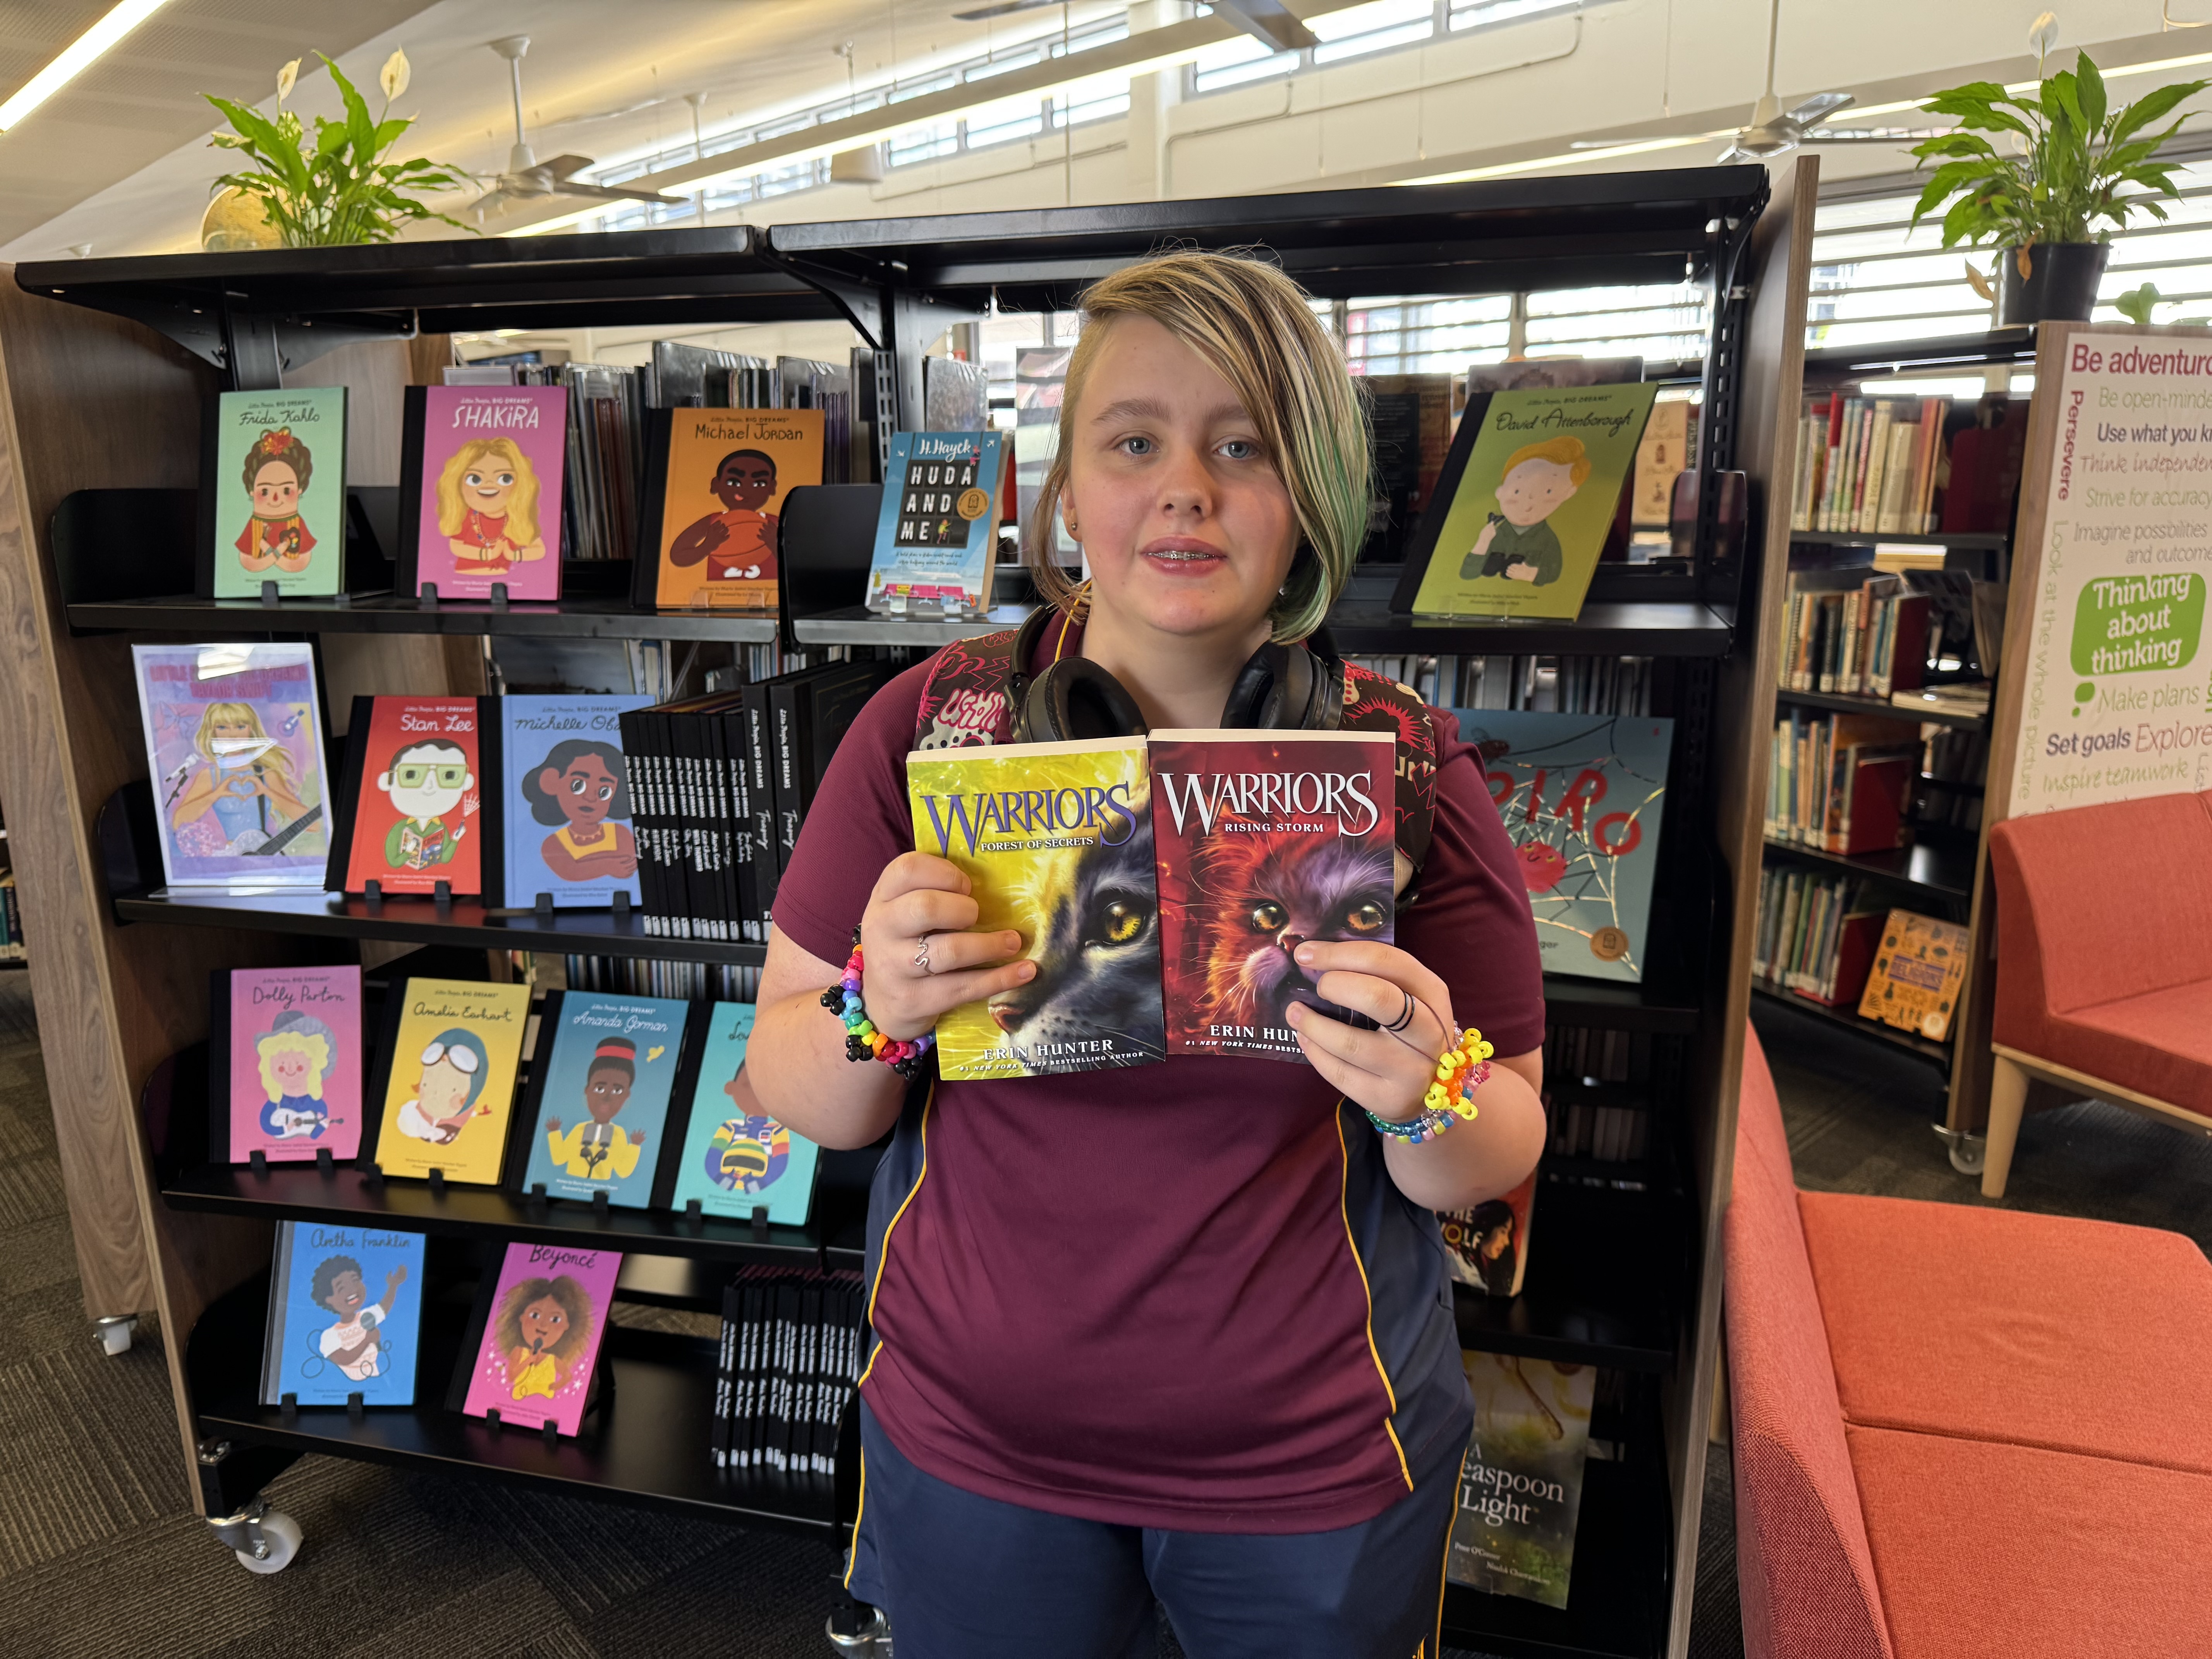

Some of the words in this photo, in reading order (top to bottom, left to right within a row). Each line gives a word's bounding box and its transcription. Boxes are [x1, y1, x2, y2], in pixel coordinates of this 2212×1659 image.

[2071, 343, 2103, 373] Be
[2109, 346, 2212, 376] adventur
[2099, 386, 2118, 408] Be
[2123, 388, 2212, 413] open-minde
[239, 409, 278, 426] Frida
[280, 407, 320, 423] Kahlo
[1496, 412, 1538, 431] David
[1542, 408, 1634, 438] Attenborough
[696, 424, 749, 440] Michael
[2098, 423, 2127, 443] Use
[2132, 424, 2167, 443] what
[2170, 427, 2197, 447] you
[919, 438, 931, 455] H.
[2057, 390, 2084, 501] Persevere
[911, 466, 972, 485] HUDA
[2081, 452, 2128, 474] Think
[2133, 450, 2212, 480] independe
[906, 493, 951, 512] AND
[2085, 487, 2126, 508] Strive
[2131, 487, 2150, 507] for
[900, 521, 930, 540] ME
[2074, 521, 2130, 546] Imagine
[2134, 519, 2208, 544] possibilities
[2126, 546, 2152, 564] and
[2156, 544, 2212, 563] outcome
[2092, 573, 2192, 610] Thinking
[2039, 610, 2057, 646] the
[2107, 605, 2171, 639] about
[2091, 637, 2183, 675] thinking
[2029, 651, 2049, 720] whole
[2097, 687, 2148, 714] Make
[2152, 684, 2200, 714] plans
[400, 714, 440, 732] Stan
[444, 714, 475, 732] Lee
[591, 715, 621, 731] Oba
[2046, 732, 2078, 757] Set
[2081, 726, 2131, 758] goals
[2135, 719, 2212, 758] Explore
[755, 759, 764, 789] DREAMS
[782, 759, 791, 789] DREAMS
[2018, 725, 2040, 800] picture
[2042, 765, 2101, 800] Inspire
[2107, 756, 2189, 787] teamwork
[1158, 770, 1378, 837] WARRIORS
[920, 781, 1136, 858] WARRIORS
[1225, 823, 1271, 832] RISING
[1276, 823, 1324, 833] STORM
[981, 840, 1023, 852] FOREST
[1027, 840, 1042, 849] OF
[1044, 836, 1094, 848] SECRETS
[253, 986, 296, 1010] Dolly
[300, 985, 345, 1004] Parton
[414, 1001, 459, 1017] Amelia
[462, 1006, 512, 1022] Earhart
[573, 1010, 623, 1028] Amanda
[623, 1014, 668, 1034] Gorman
[1210, 1025, 1254, 1038] ERIN
[1263, 1027, 1298, 1042] HUN
[983, 1046, 1028, 1060] ERIN
[1037, 1039, 1114, 1057] HUNTER
[1050, 1055, 1106, 1065] BESTSELLING
[1110, 1051, 1144, 1060] AUTHOR
[311, 1228, 354, 1248] Aretha
[361, 1228, 409, 1250] Franklin
[529, 1244, 598, 1269] Beyoncé
[1461, 1460, 1565, 1503] easpoon
[1460, 1484, 1531, 1527] Light
